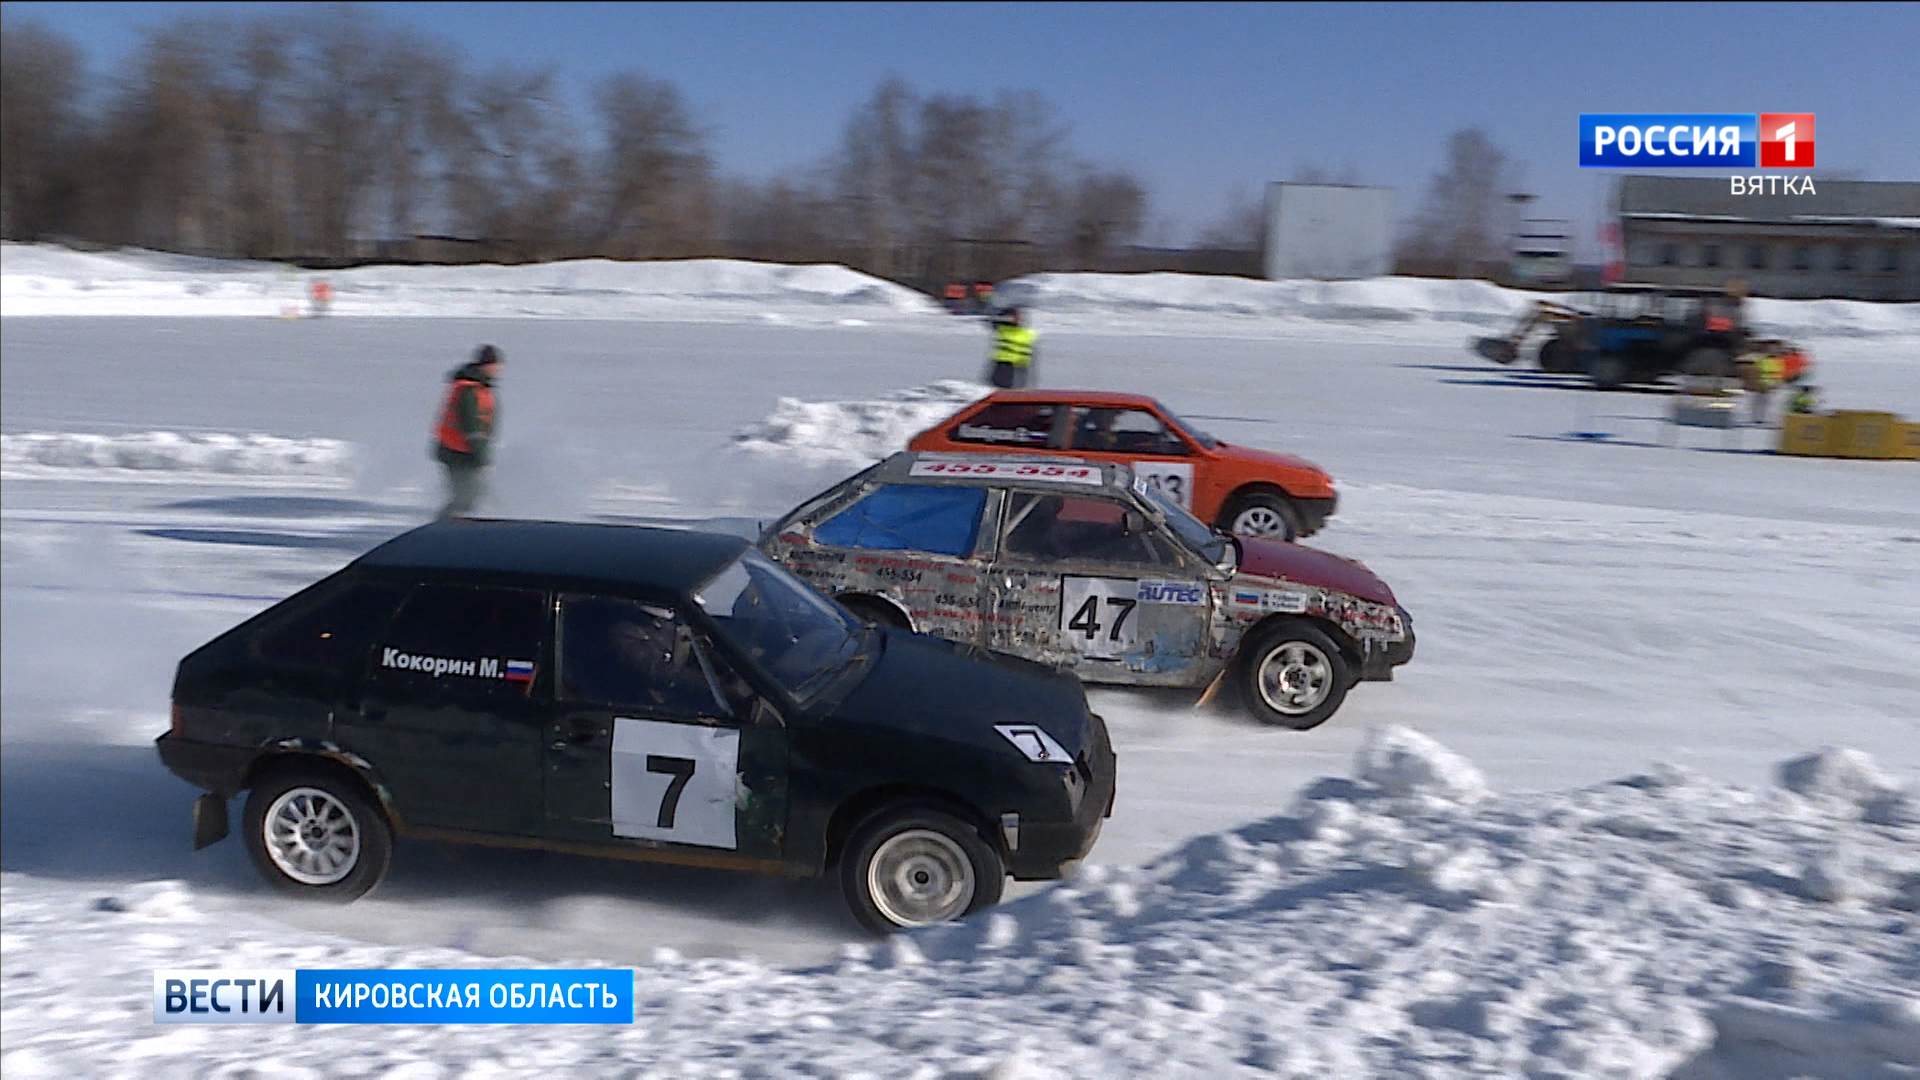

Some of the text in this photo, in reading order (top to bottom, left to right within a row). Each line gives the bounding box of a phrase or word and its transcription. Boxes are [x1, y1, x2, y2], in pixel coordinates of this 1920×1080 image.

[1068, 595, 1137, 641] 47
[382, 647, 504, 678] Кокорин М.
[646, 754, 696, 828] 7
